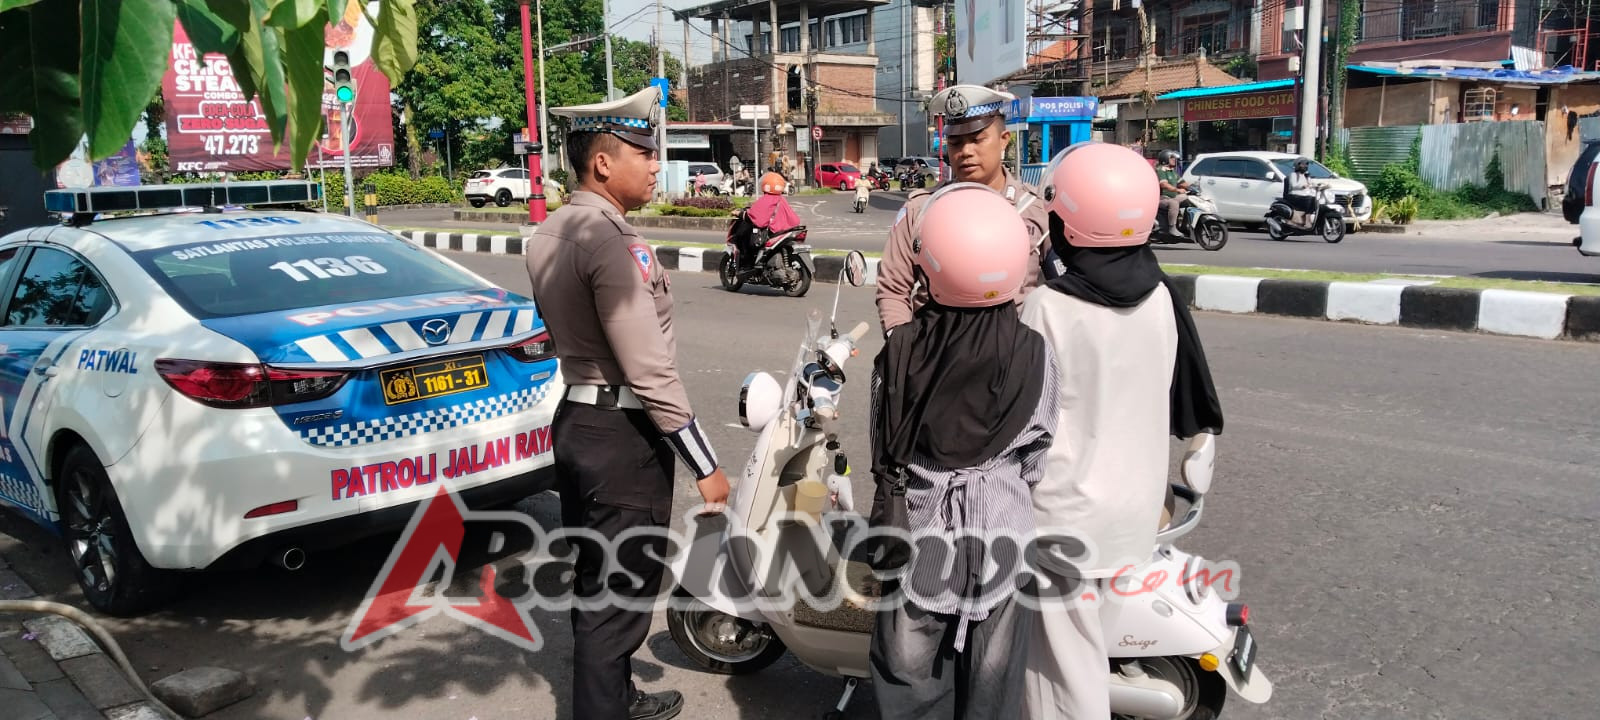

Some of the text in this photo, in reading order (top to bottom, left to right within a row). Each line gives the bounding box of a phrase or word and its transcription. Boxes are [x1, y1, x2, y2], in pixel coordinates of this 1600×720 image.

[172, 43, 197, 59] KF
[174, 60, 233, 76] CHIC
[203, 92, 238, 100] COMBO
[1187, 93, 1295, 112] CHINESE FOOD CITA
[202, 103, 256, 117] COCA-COLA
[1040, 102, 1056, 110] POS
[181, 117, 269, 130] ZERO SUGA
[177, 161, 204, 171] KFC
[194, 216, 302, 230] 1136
[172, 239, 269, 261] SATLANTAS
[269, 235, 329, 249] POLRES
[268, 255, 388, 282] 1136
[286, 292, 505, 327] POLISI
[77, 349, 138, 374] PATWAL
[424, 373, 455, 393] 1161
[463, 369, 481, 386] 31
[331, 453, 437, 500] PATROLI
[443, 436, 511, 480] JALAN
